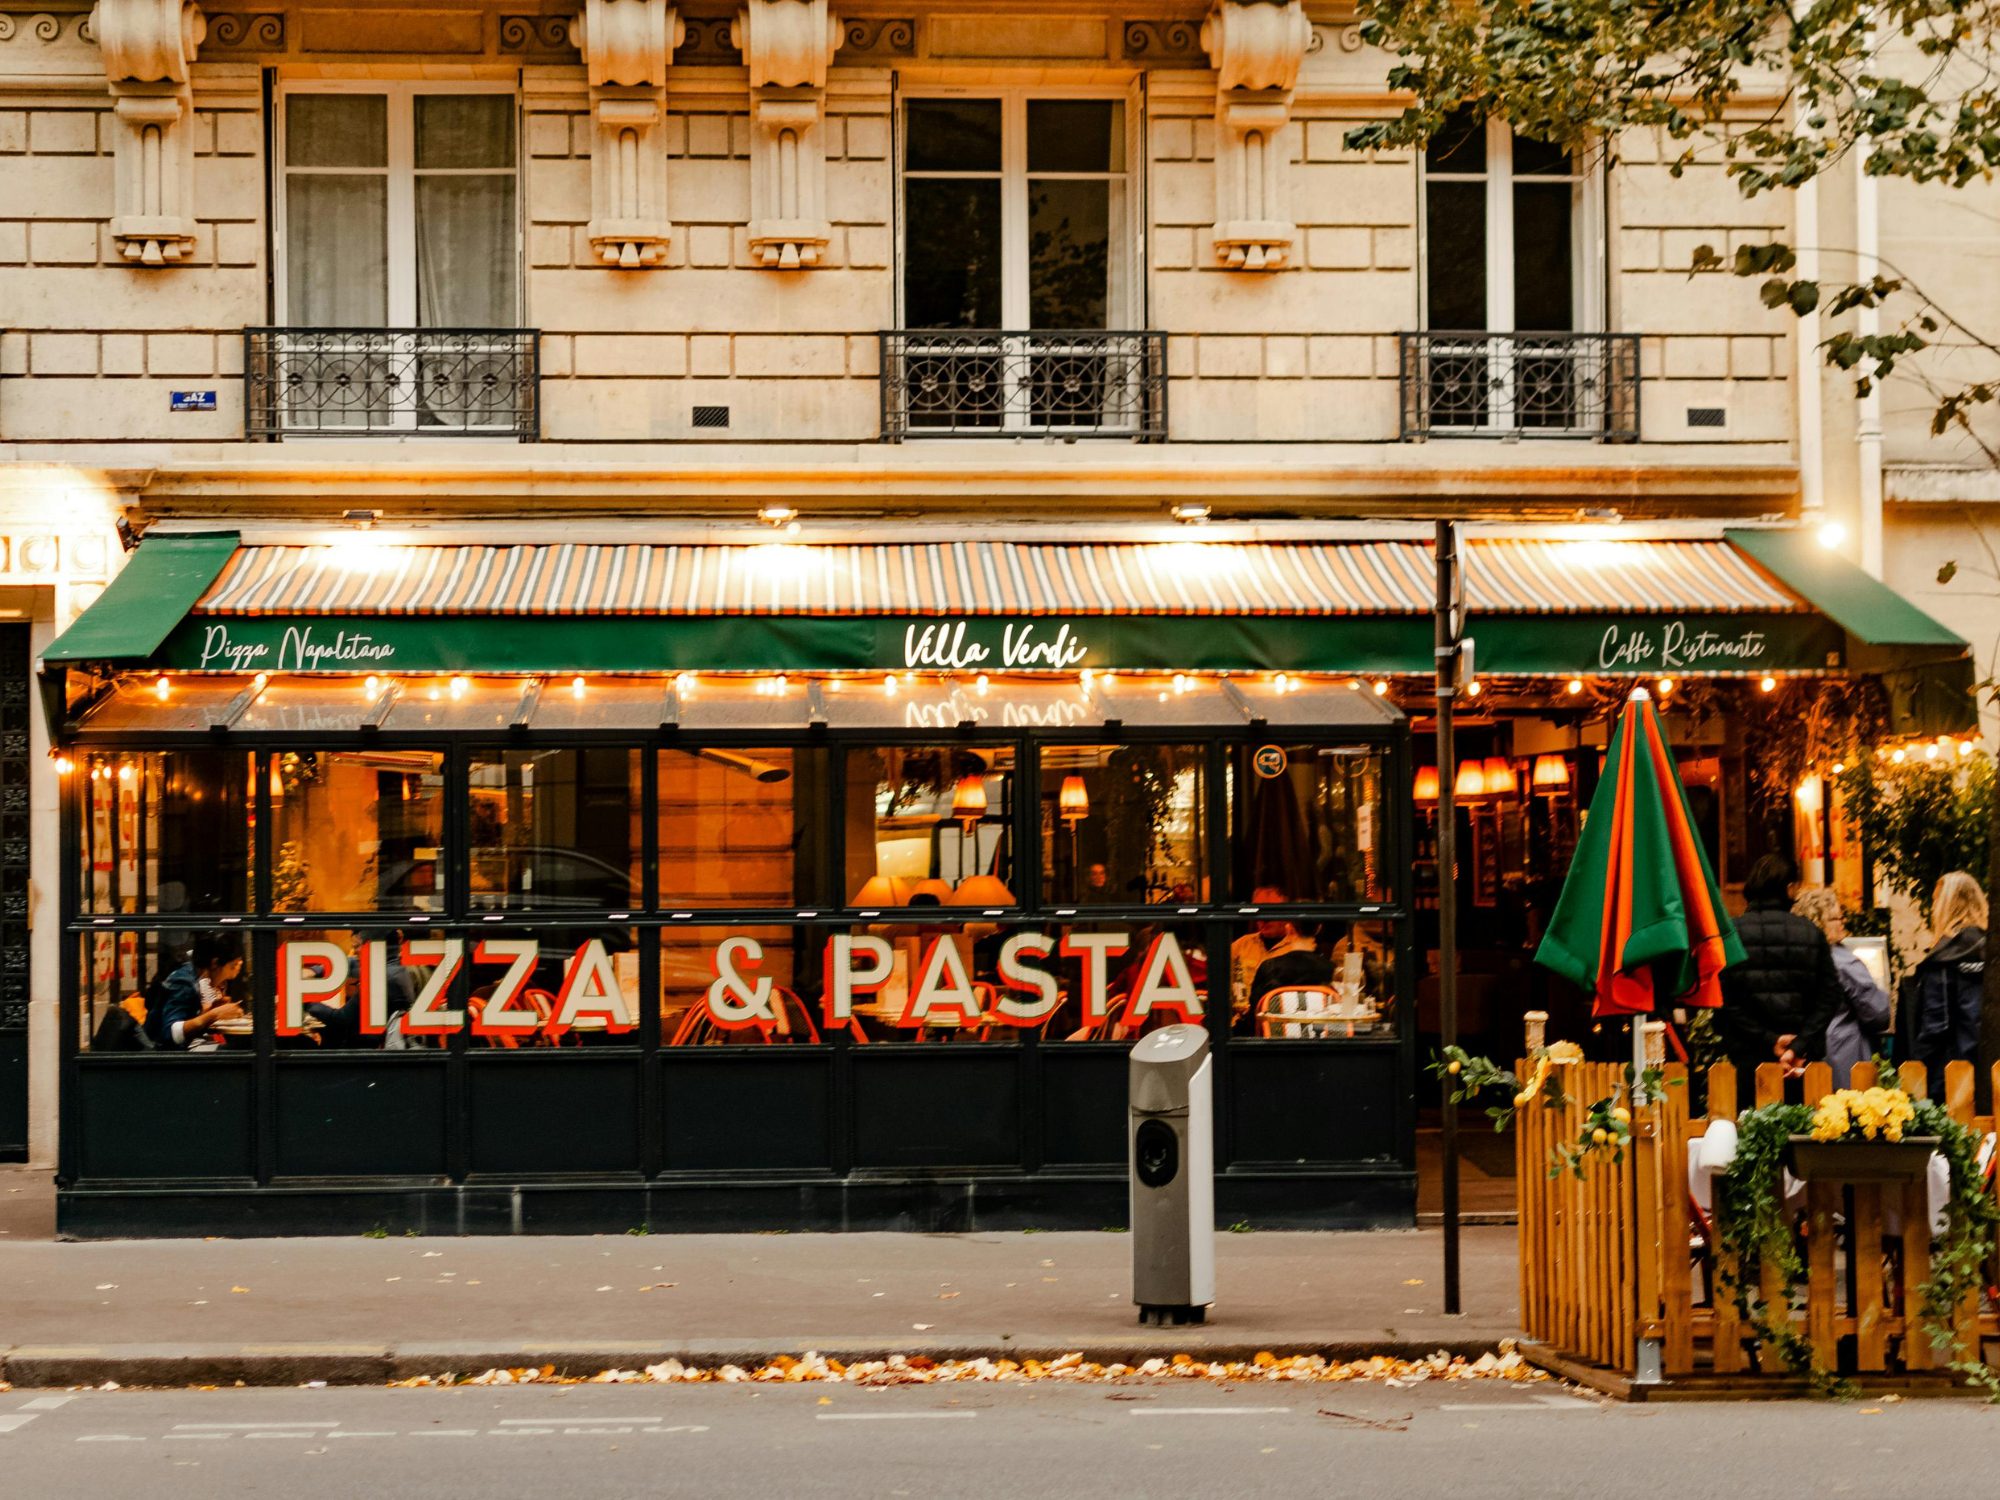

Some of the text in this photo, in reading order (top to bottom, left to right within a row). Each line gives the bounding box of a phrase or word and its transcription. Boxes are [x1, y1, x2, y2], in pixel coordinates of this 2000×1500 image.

[200, 624, 395, 671] Pizza Napoletana
[904, 621, 1089, 668] Villa Verdi
[1661, 620, 1767, 667] Ristorante
[276, 931, 1206, 1036] PIZZA & PASTA
